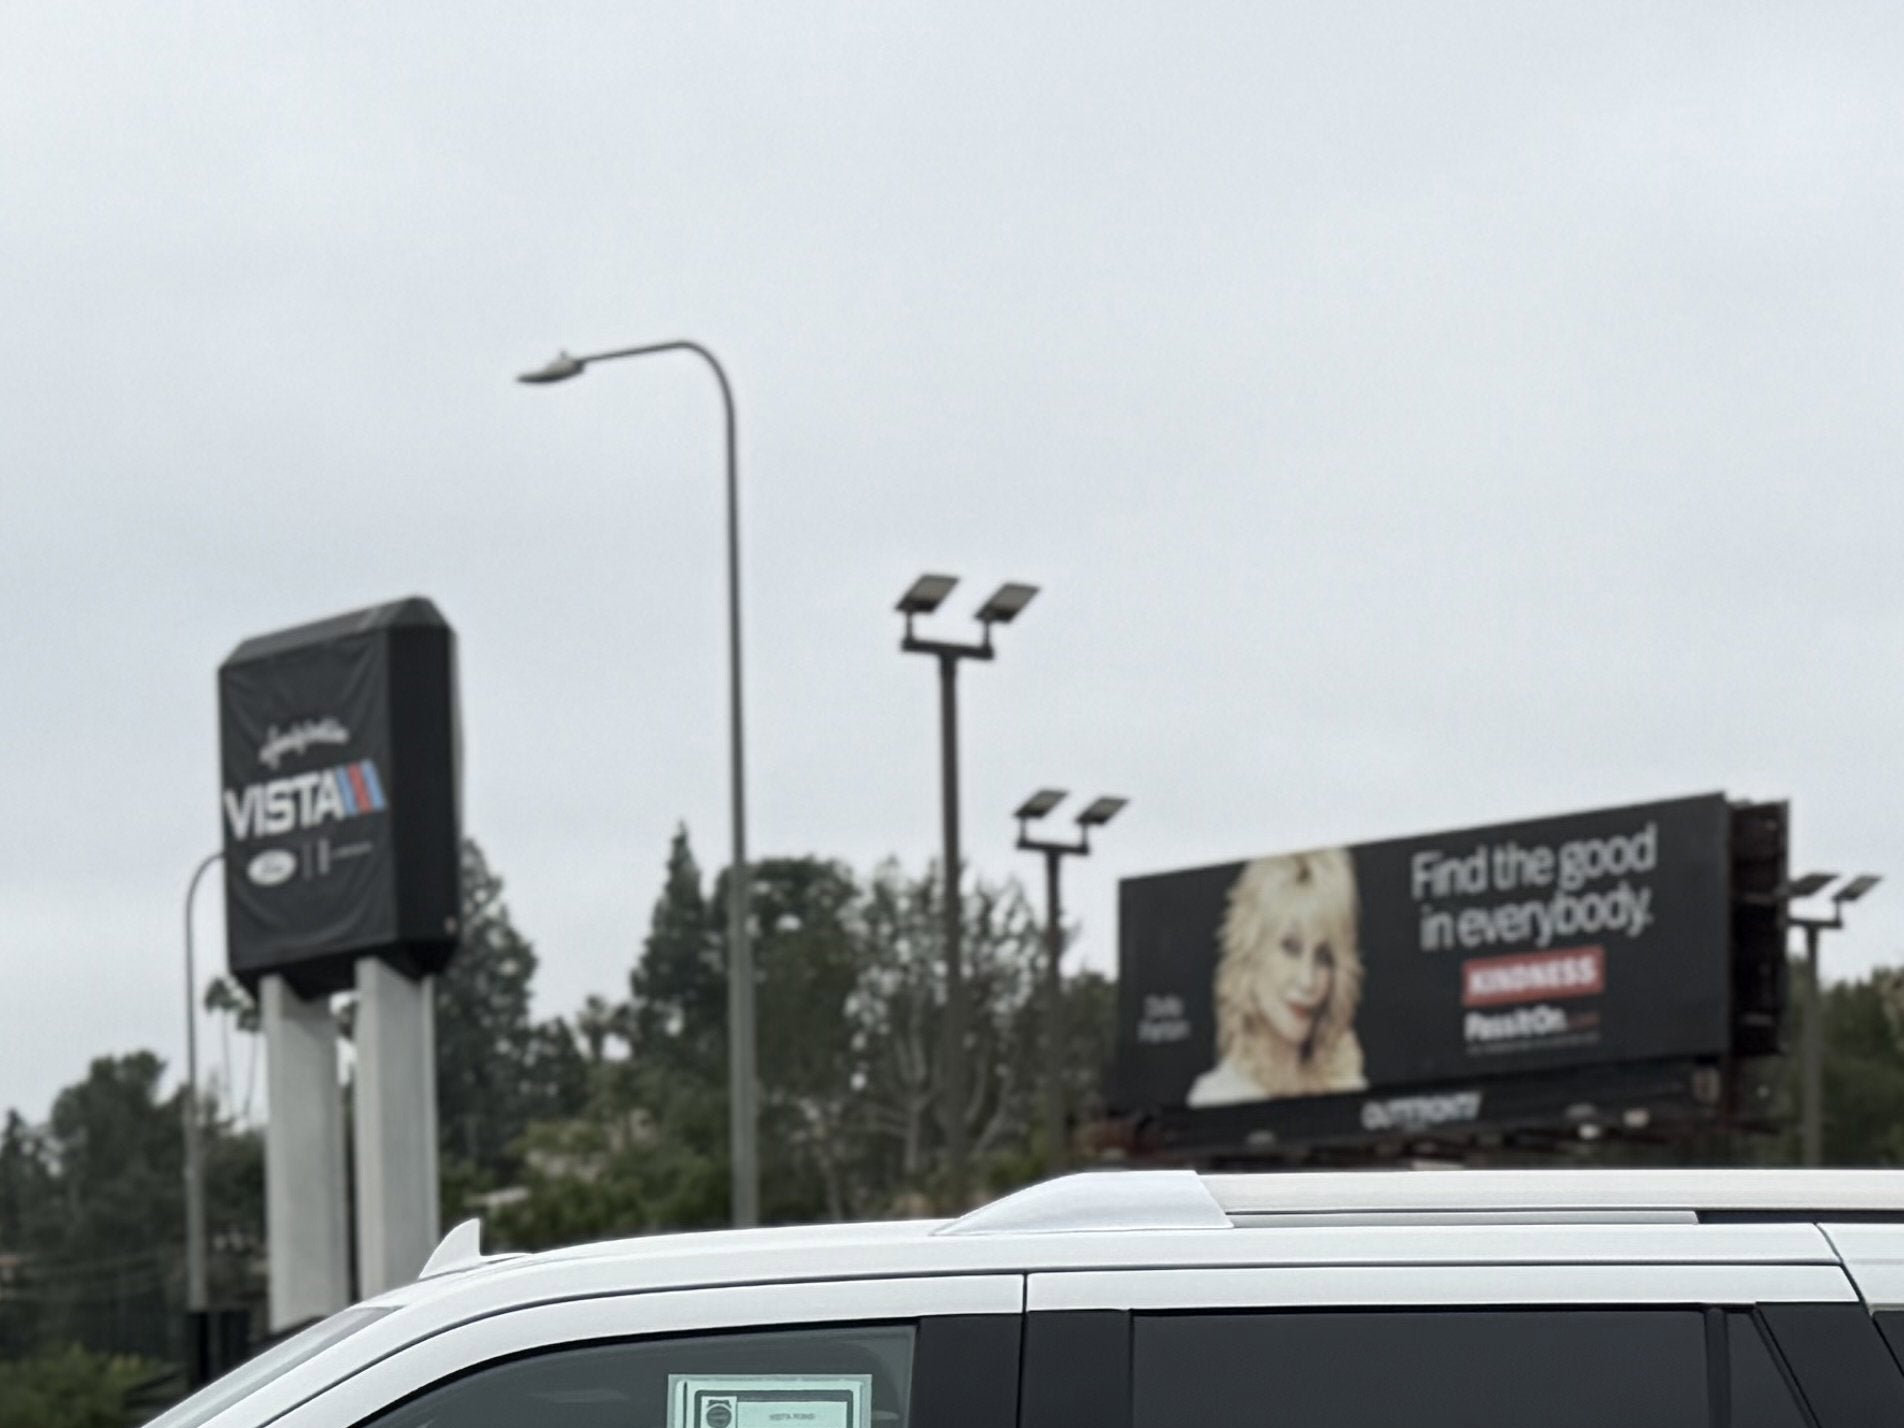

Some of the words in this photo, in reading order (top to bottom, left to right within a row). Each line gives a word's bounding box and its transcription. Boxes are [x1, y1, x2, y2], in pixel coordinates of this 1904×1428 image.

[223, 769, 345, 841] VISTA
[1411, 845, 1487, 899] Find
[1492, 841, 1554, 890] the
[1558, 821, 1658, 890] good
[1420, 903, 1455, 951] in
[1458, 880, 1654, 947] everybody.
[1468, 955, 1596, 995] KINDNESS
